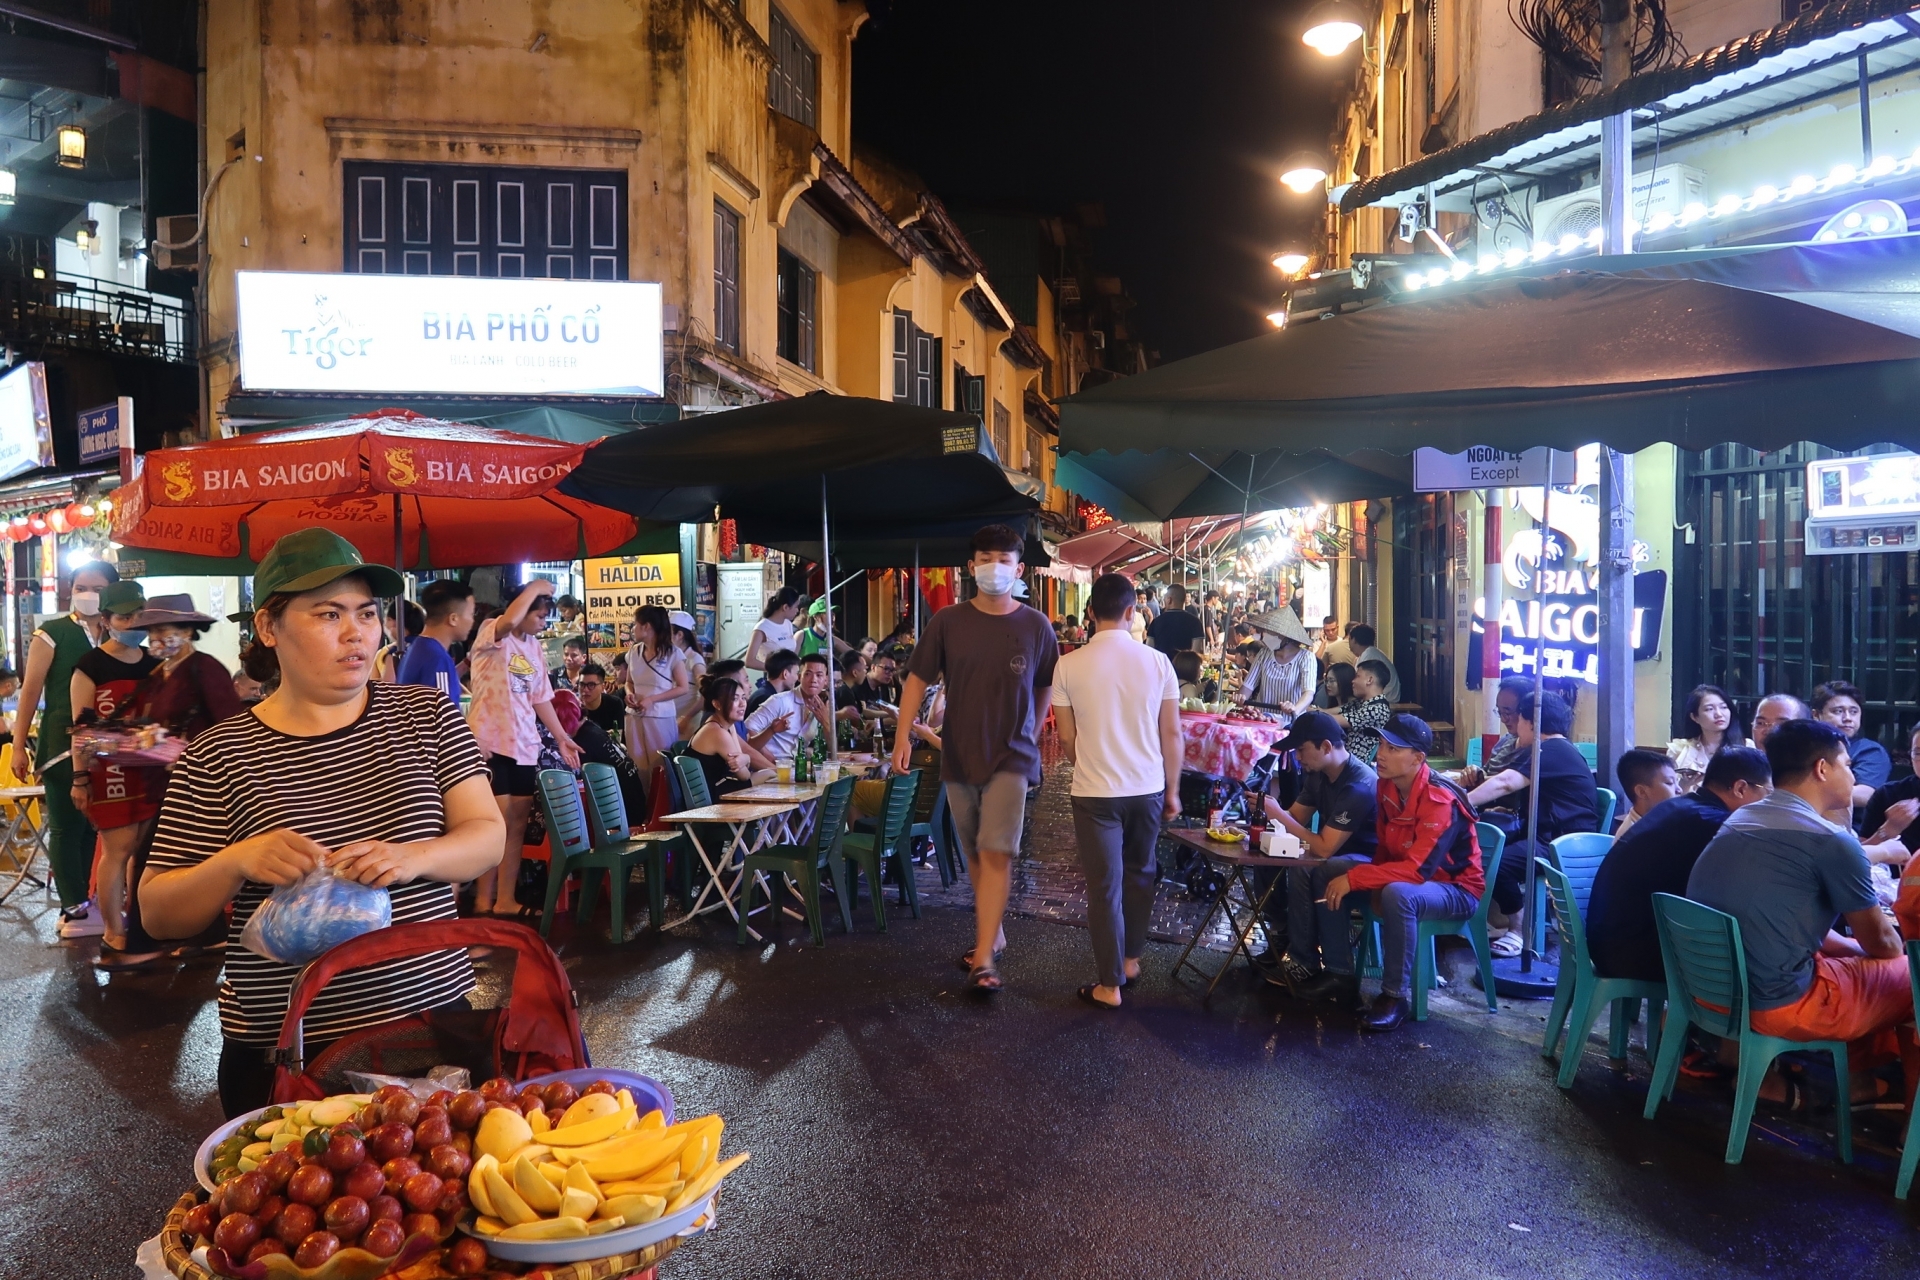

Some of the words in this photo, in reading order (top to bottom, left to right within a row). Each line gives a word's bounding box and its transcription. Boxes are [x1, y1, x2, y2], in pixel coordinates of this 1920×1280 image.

[421, 311, 476, 342] BIA
[487, 304, 553, 343] PHỐ
[560, 304, 603, 344] CỔ
[281, 326, 374, 370] Tiger
[549, 355, 578, 368] BEER
[92, 411, 107, 428] PHỐ
[204, 468, 249, 491] BIA
[258, 458, 346, 487] SAIGON
[426, 461, 473, 483] BIA
[482, 461, 572, 485] SAIGON
[1471, 466, 1520, 482] Except
[600, 565, 663, 583] HALIDA
[1536, 570, 1587, 595] BIA
[590, 596, 612, 608] BIA
